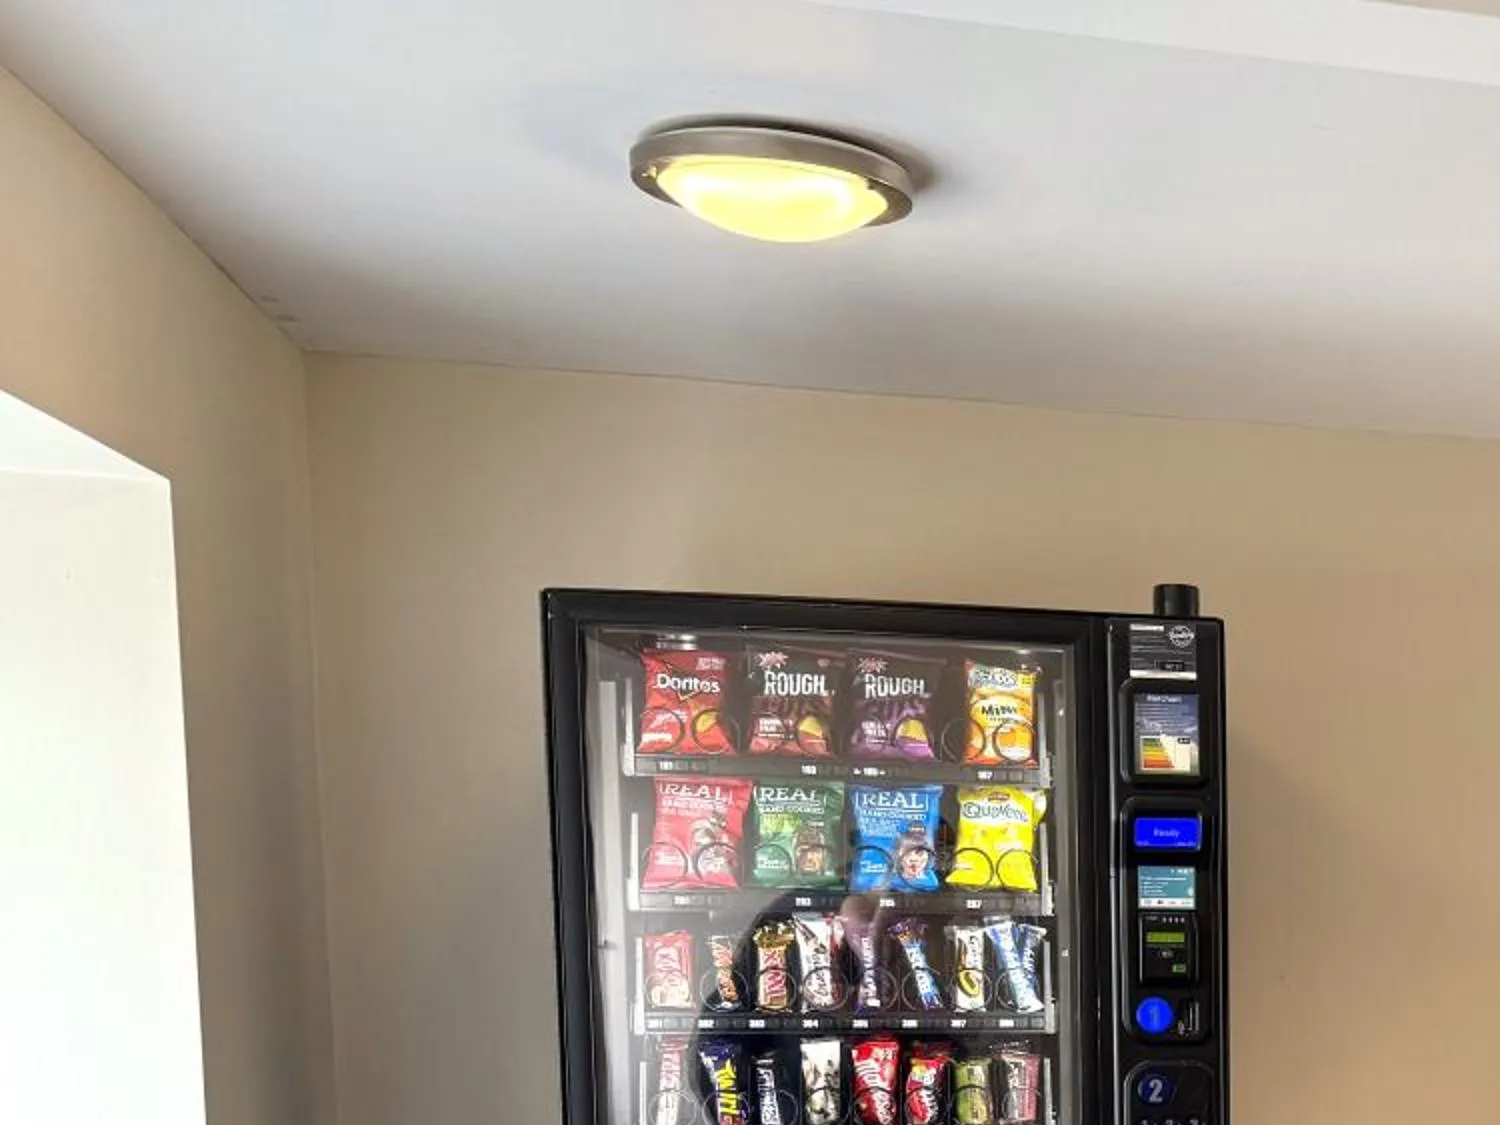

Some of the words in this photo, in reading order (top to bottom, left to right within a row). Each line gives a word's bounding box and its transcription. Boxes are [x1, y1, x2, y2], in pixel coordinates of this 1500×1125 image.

[656, 673, 721, 694] Doritos
[764, 671, 828, 697] ROUGH
[864, 673, 926, 698] ROUGH
[861, 791, 925, 808] REAL
[1148, 1079, 1163, 1103] 2
